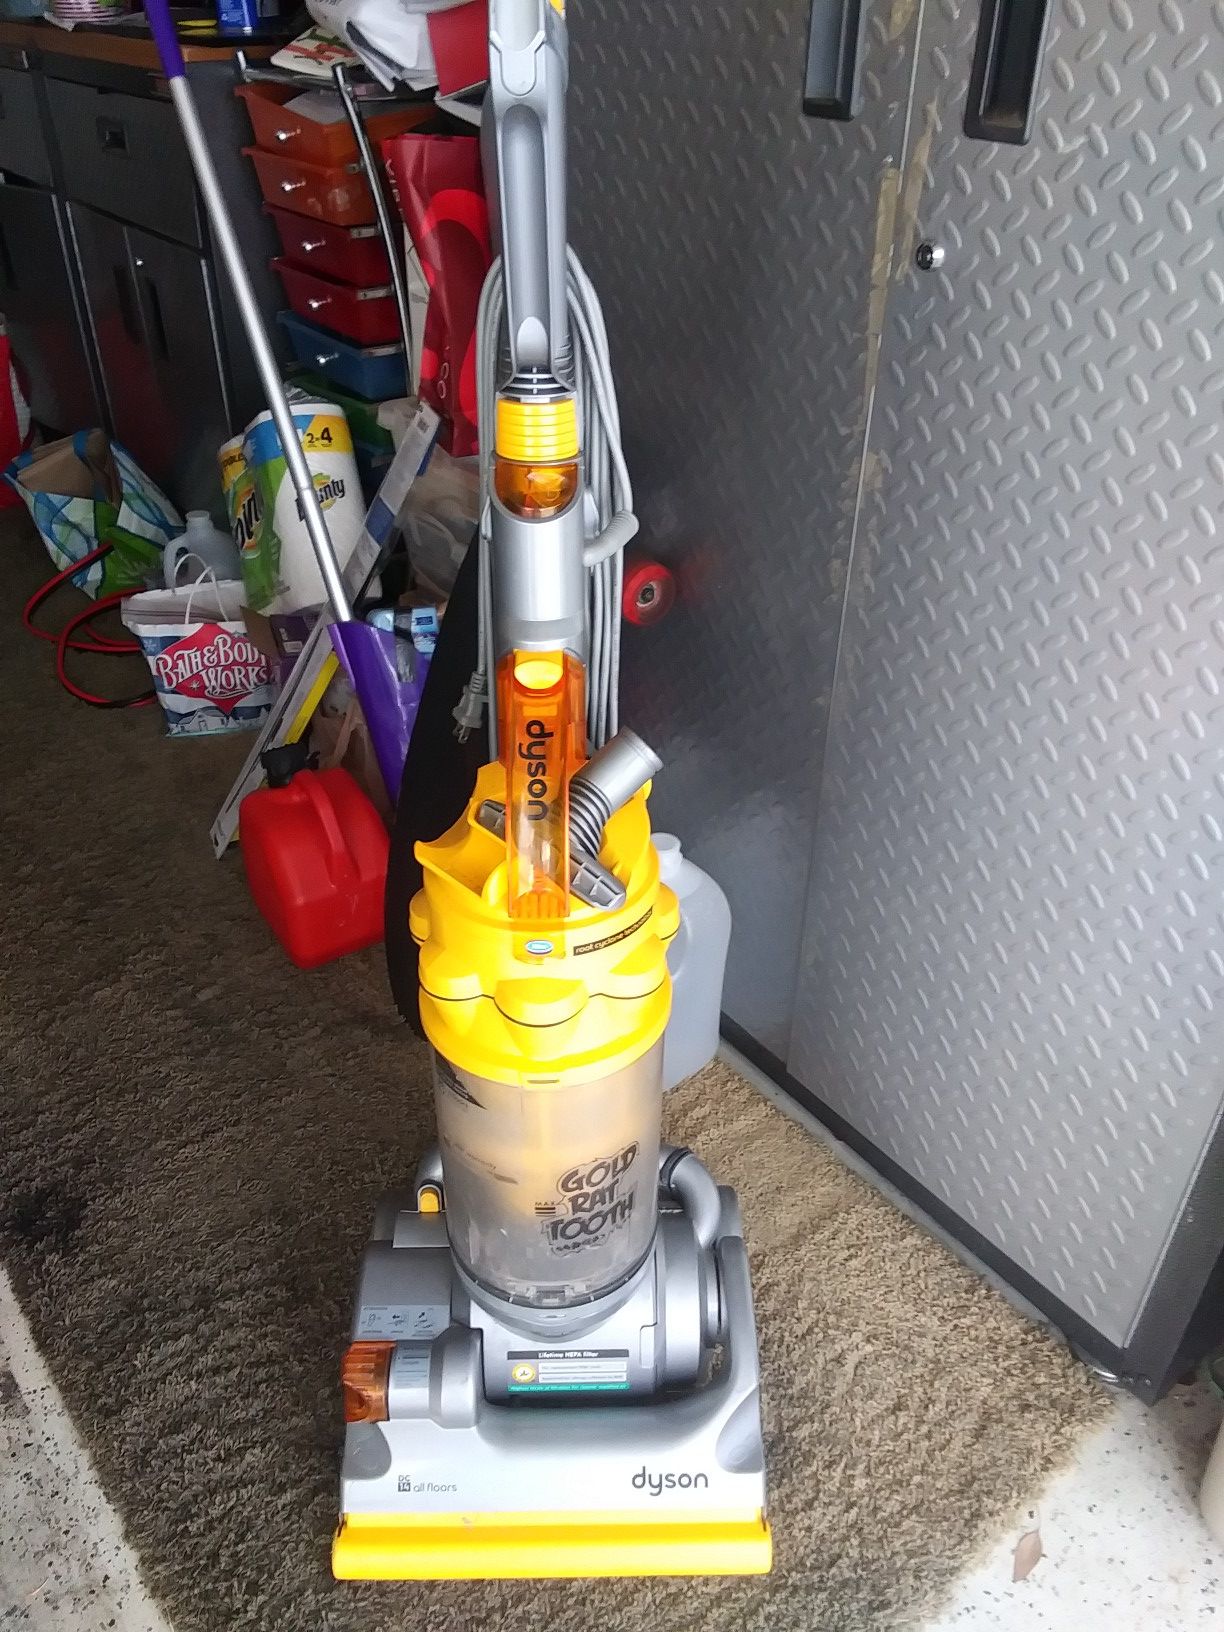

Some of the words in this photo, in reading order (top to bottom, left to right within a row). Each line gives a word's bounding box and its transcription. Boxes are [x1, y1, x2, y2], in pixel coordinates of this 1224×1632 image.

[200, 666, 268, 697] WORKS
[518, 719, 555, 821] dyson
[574, 943, 594, 955] root
[561, 1144, 637, 1193] GOLD
[568, 1178, 620, 1216] RAT
[550, 1190, 634, 1241] TOOTH
[538, 1351, 564, 1359] Lifetime
[398, 1474, 411, 1482] DC
[631, 1465, 709, 1497] dyson
